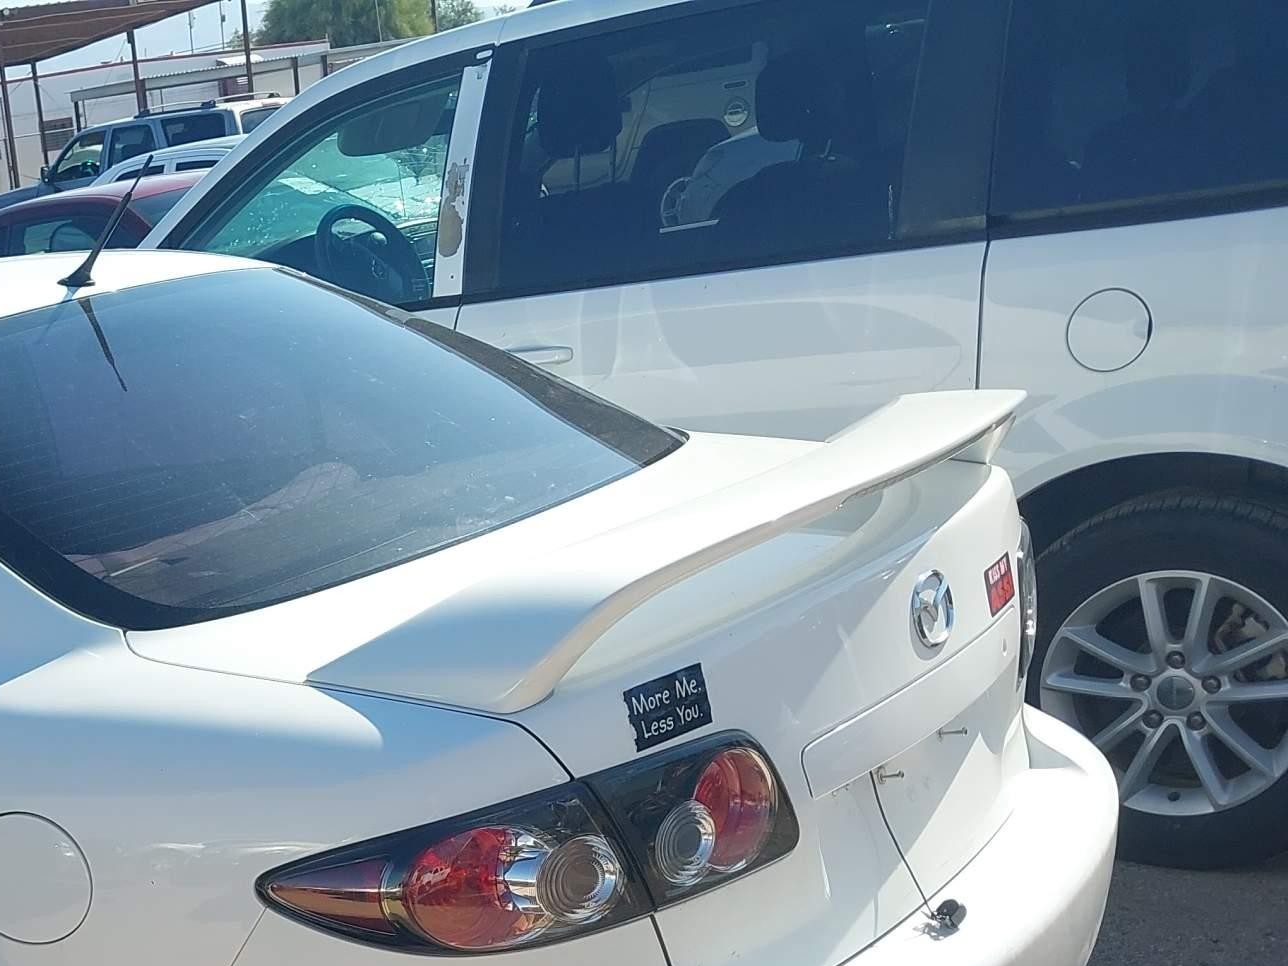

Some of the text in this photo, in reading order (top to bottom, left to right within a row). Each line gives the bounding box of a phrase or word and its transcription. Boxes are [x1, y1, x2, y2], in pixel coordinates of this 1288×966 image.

[631, 690, 670, 715] More
[641, 704, 704, 739] Less You.
